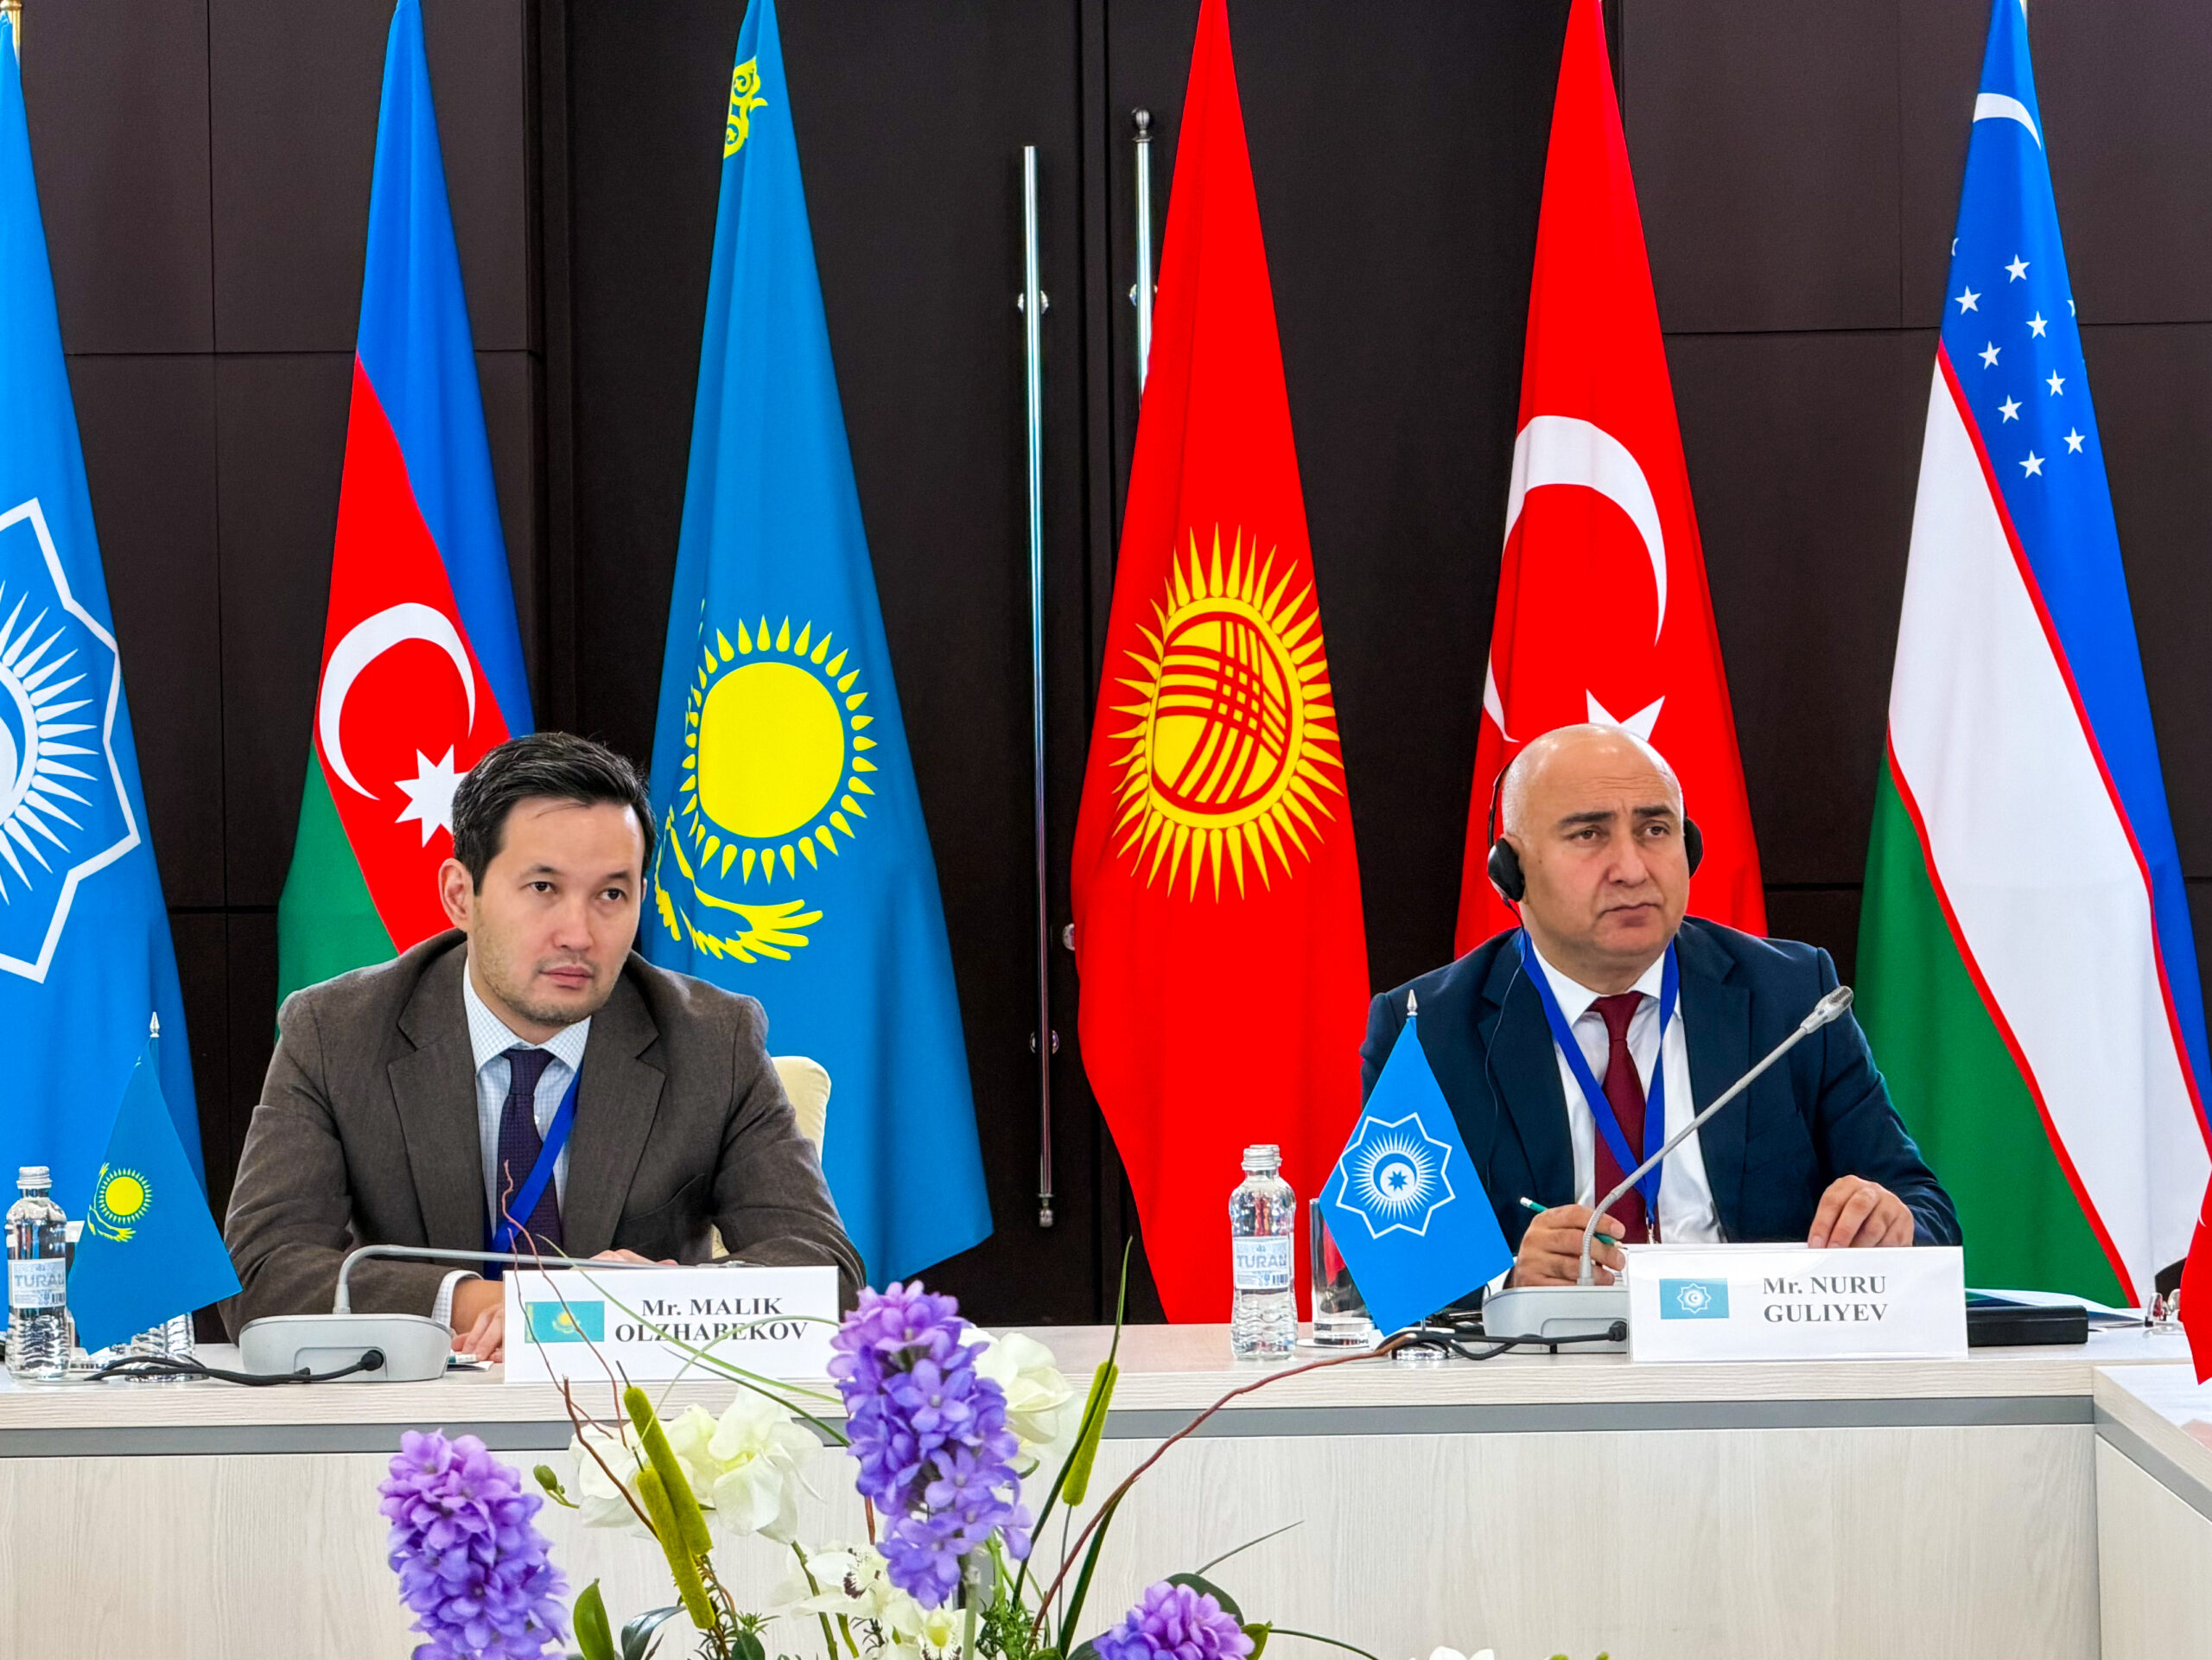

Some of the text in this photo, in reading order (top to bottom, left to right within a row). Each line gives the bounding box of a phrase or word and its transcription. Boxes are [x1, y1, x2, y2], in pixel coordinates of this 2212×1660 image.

[1236, 1254, 1287, 1268] TURAN
[1763, 1275, 1886, 1294] Mr. NURU
[642, 1298, 783, 1316] Mr. MALIK
[1764, 1303, 1888, 1323] GULIYEV
